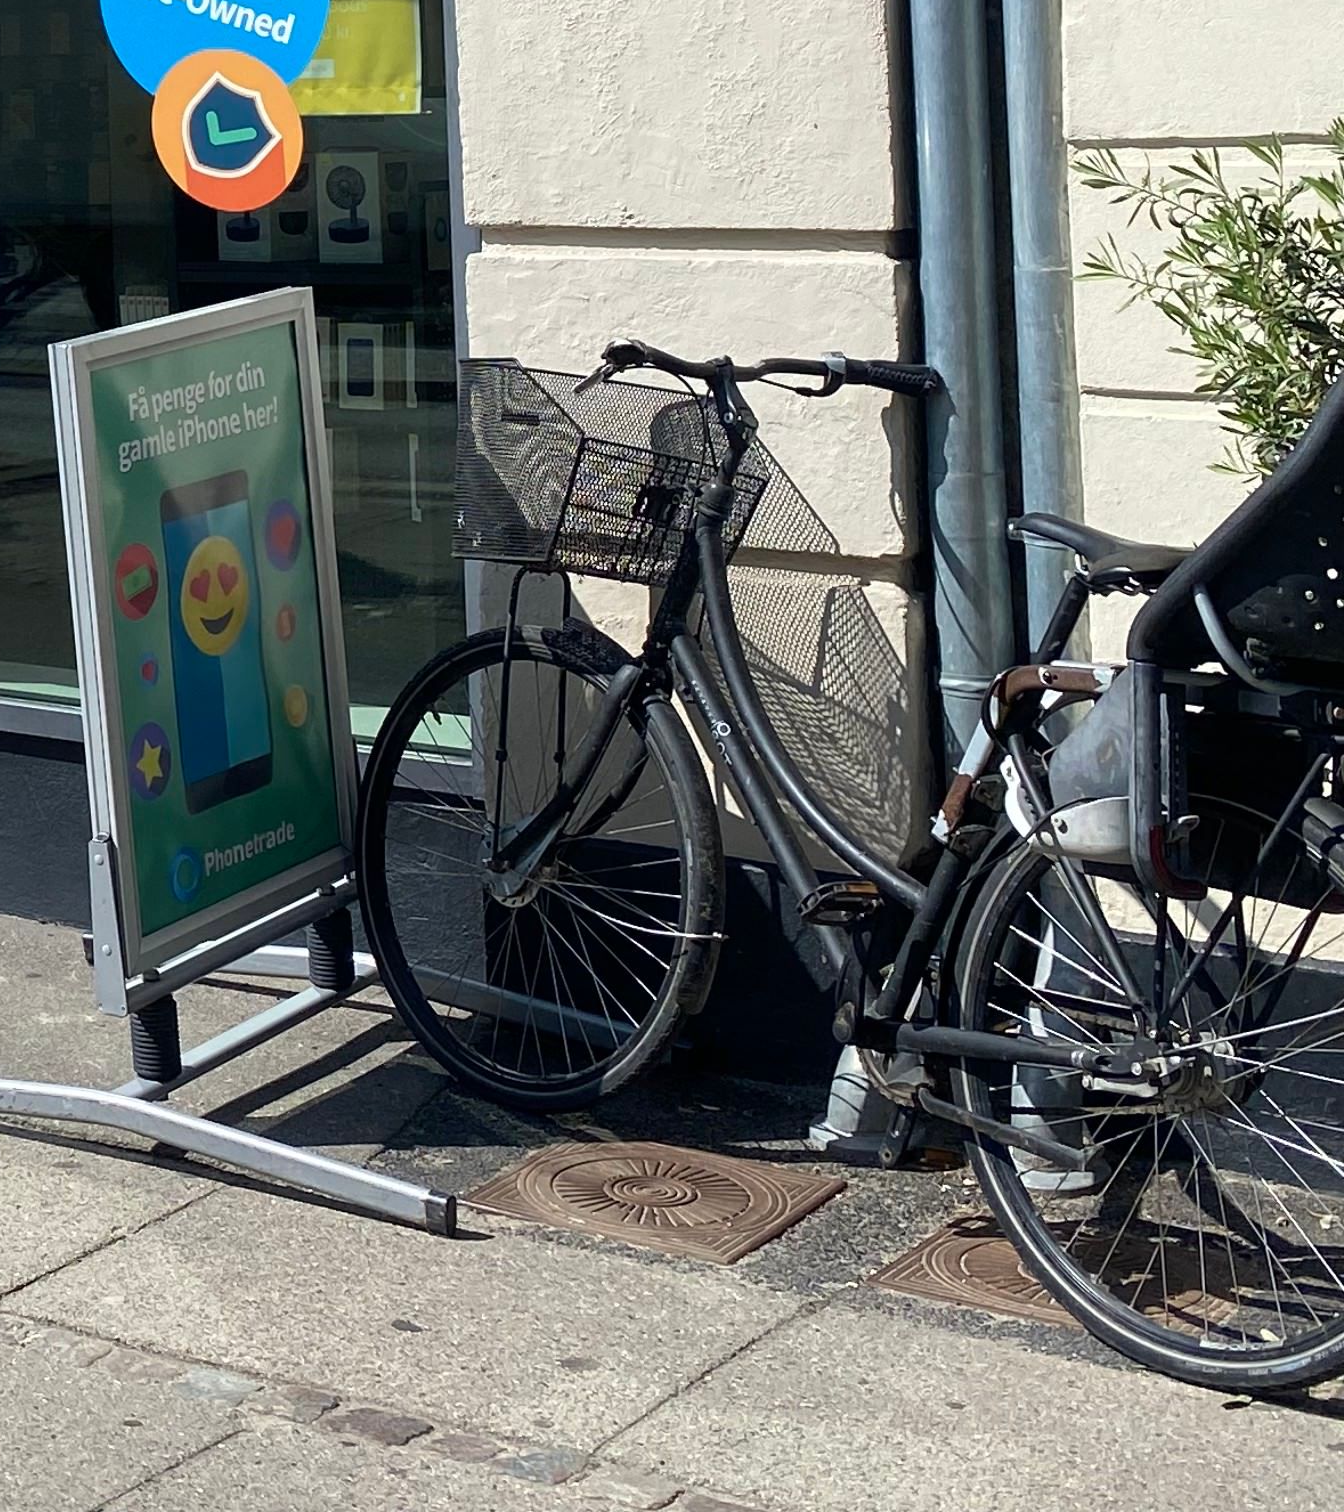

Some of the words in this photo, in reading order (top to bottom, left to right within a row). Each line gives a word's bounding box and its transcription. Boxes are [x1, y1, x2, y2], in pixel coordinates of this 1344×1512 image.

[128, 386, 150, 422] Få
[151, 381, 205, 423] penge
[208, 370, 233, 400] for
[236, 360, 265, 393] din
[118, 424, 177, 473] gamle
[178, 414, 242, 449] iPhone
[243, 395, 279, 432] her!
[204, 820, 296, 877] Phonetrade
